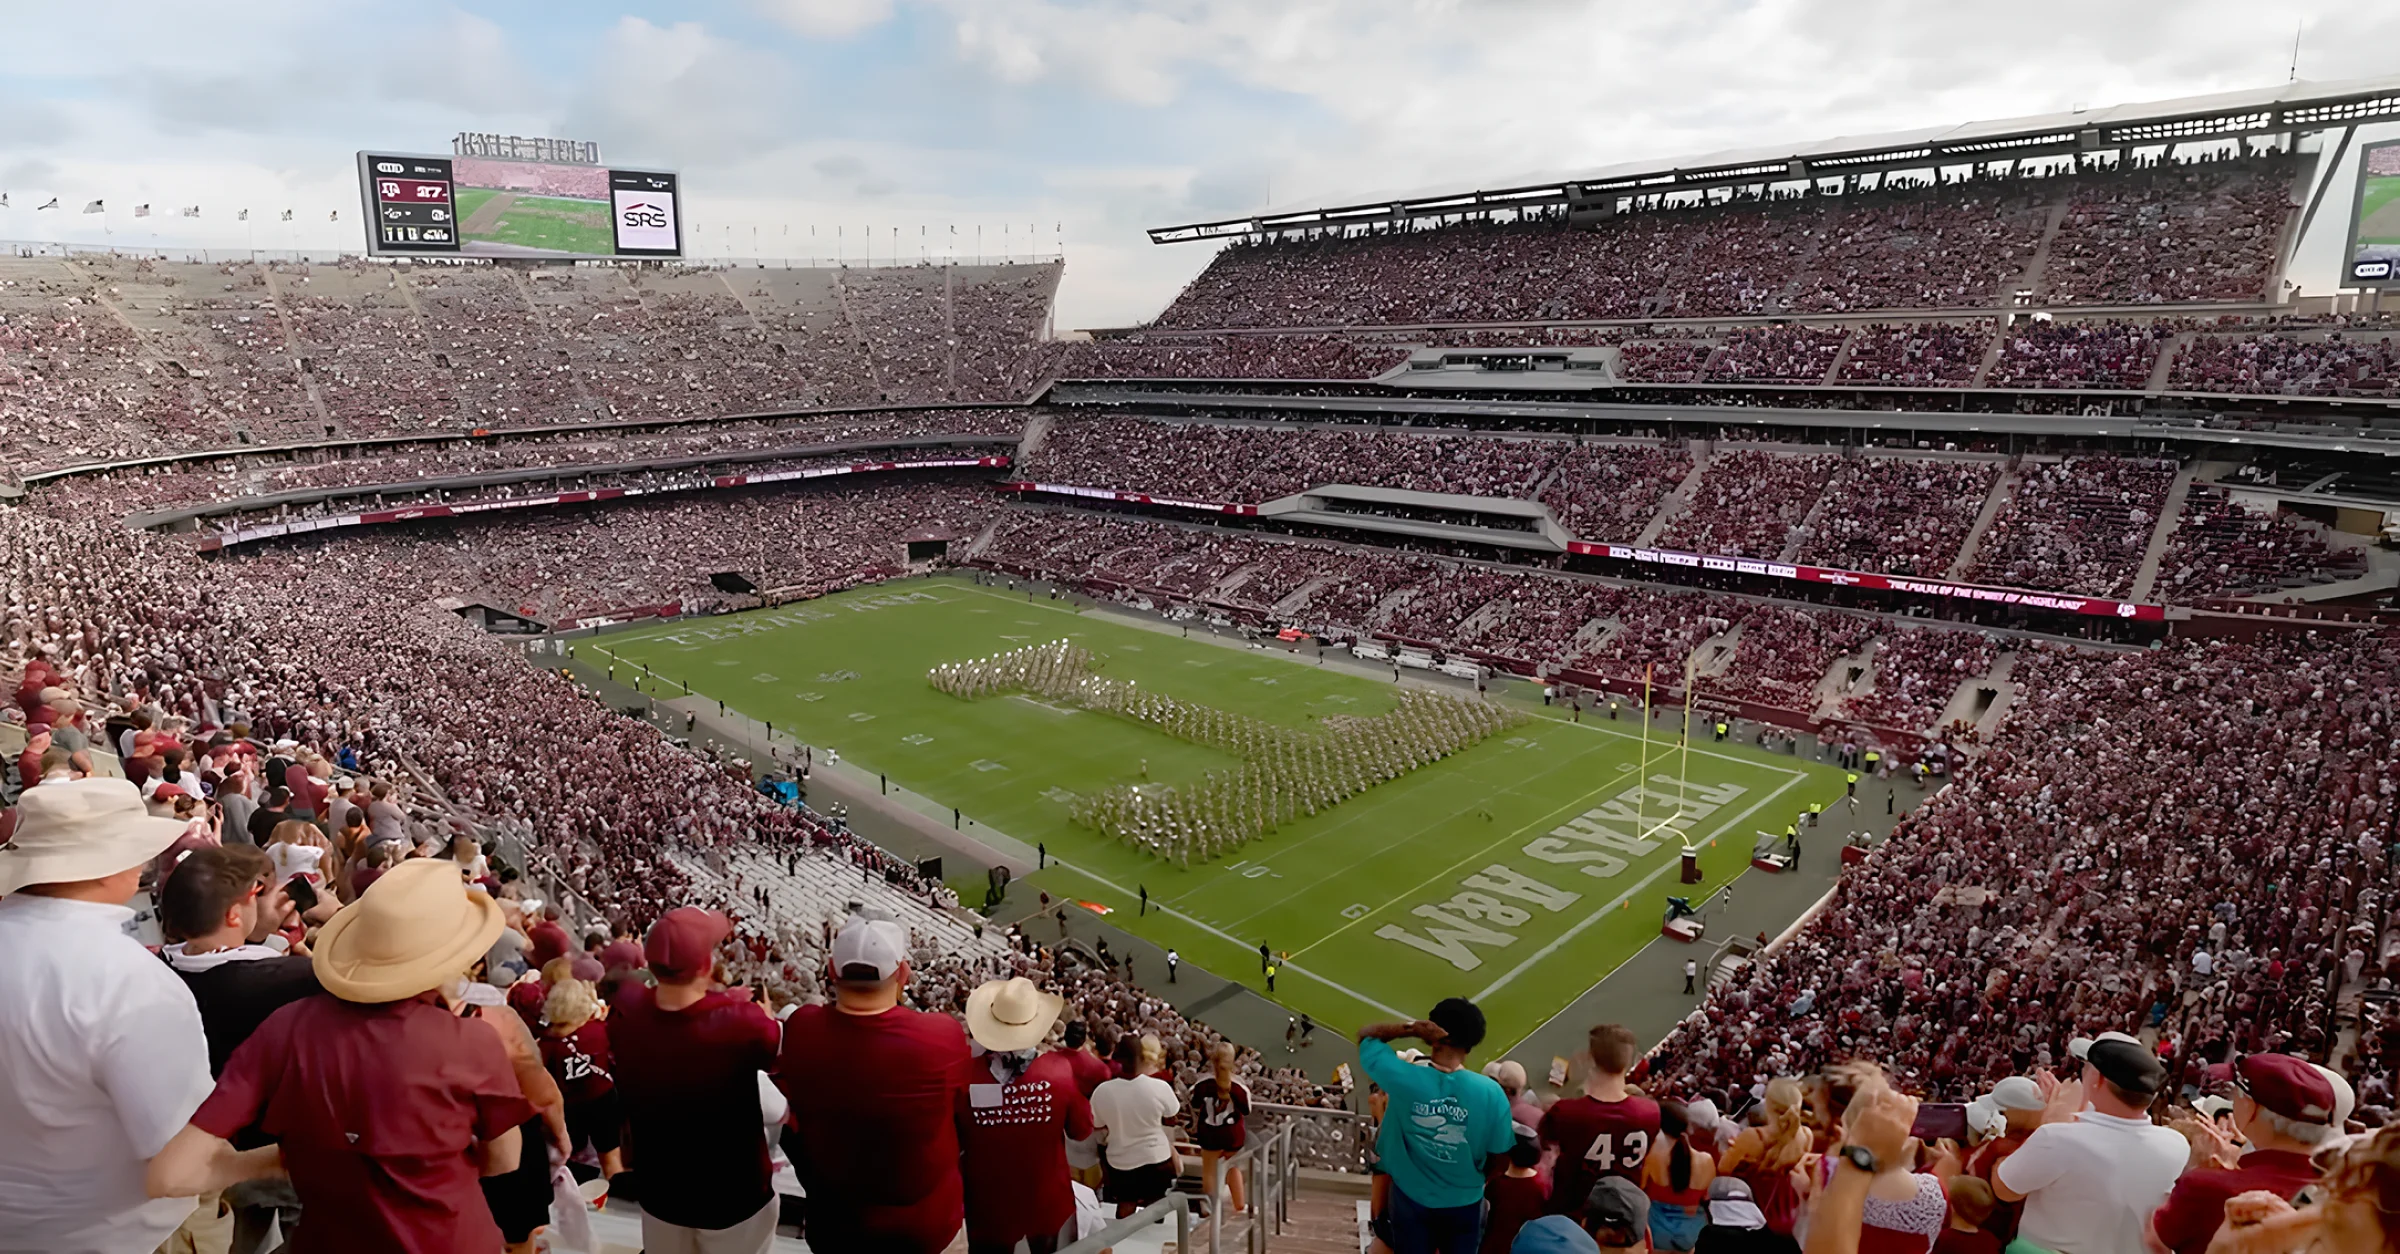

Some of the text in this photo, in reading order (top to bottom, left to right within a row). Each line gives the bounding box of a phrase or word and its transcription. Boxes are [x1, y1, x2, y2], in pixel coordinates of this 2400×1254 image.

[623, 211, 667, 228] SRS
[1373, 773, 1749, 972] TEXAS A&M
[563, 1053, 591, 1081] 12
[1583, 1129, 1648, 1170] 43
